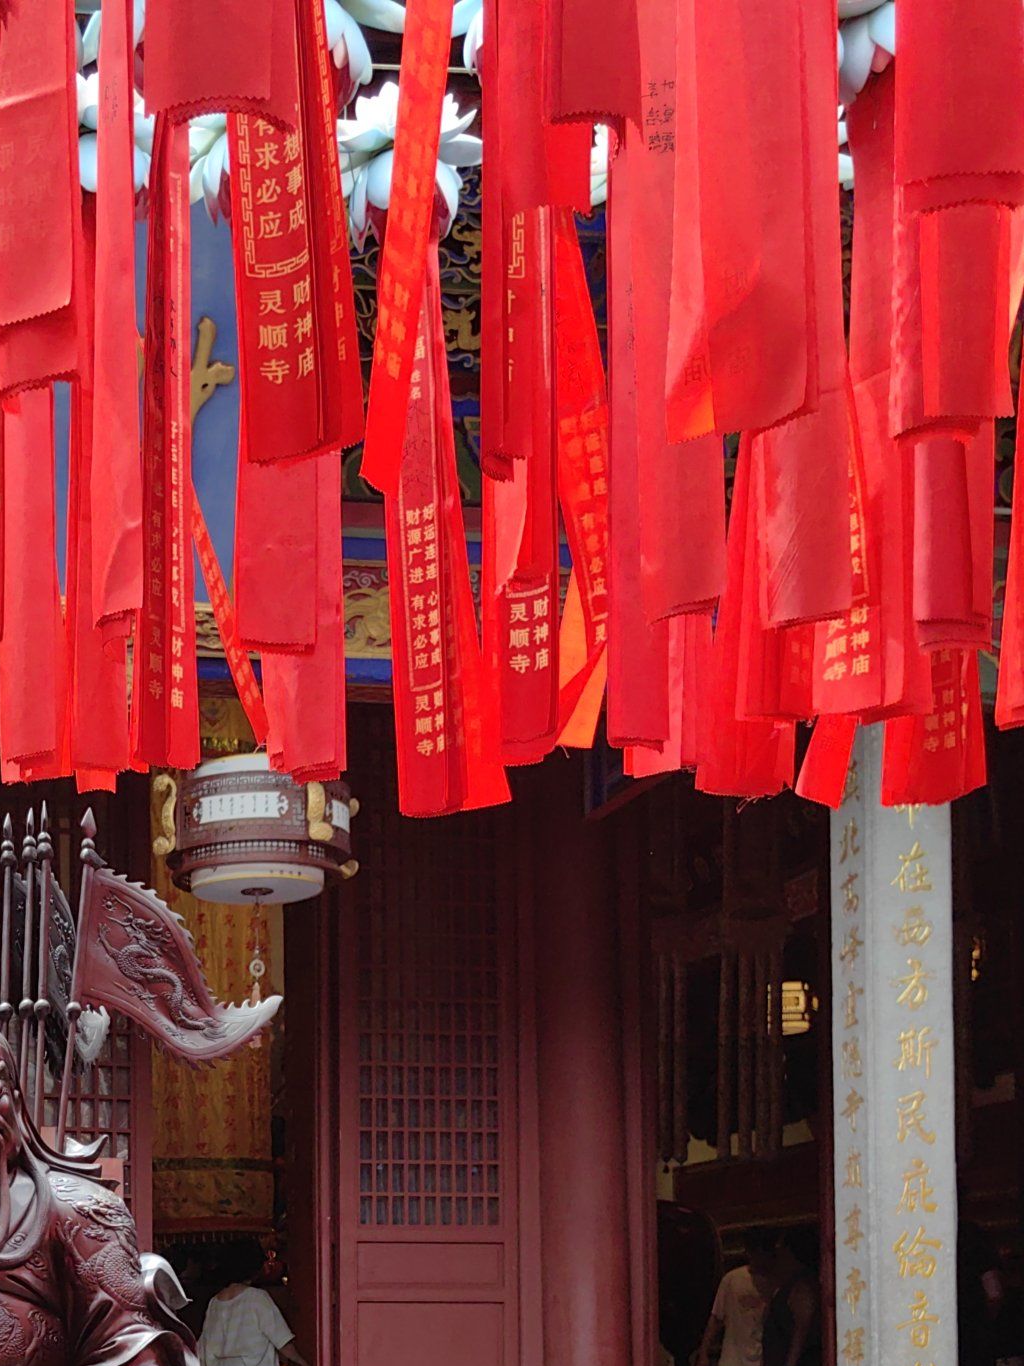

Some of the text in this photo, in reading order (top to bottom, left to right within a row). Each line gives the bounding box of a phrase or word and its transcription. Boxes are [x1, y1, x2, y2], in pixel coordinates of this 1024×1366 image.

[258, 290, 290, 385] 灵顺寺
[293, 274, 315, 380] 财神庙
[406, 509, 425, 584] 财源广进
[411, 594, 429, 669] 有求必应
[509, 602, 530, 674] 灵顺寺
[533, 595, 549, 671] 财神庙
[850, 603, 870, 676] 财神庙
[415, 695, 434, 757] 灵顺寺
